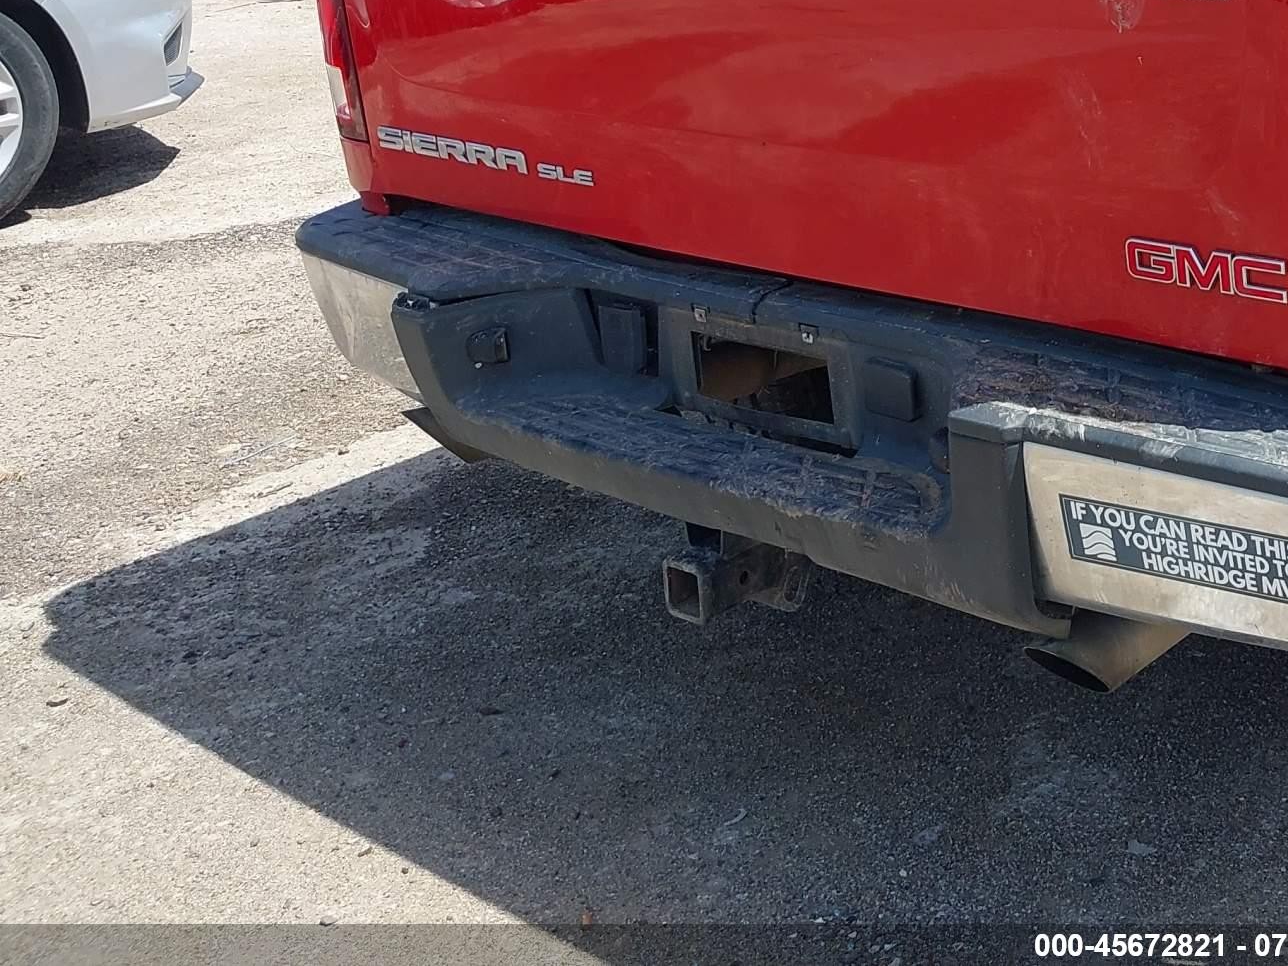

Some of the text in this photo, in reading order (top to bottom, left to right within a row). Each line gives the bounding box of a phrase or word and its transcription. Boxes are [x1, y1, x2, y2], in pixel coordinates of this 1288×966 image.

[377, 125, 594, 186] SIERRA SLE
[1125, 238, 1288, 304] GMC
[1069, 500, 1087, 520] IF
[1088, 503, 1136, 530] YOU
[1139, 514, 1187, 540] CAN
[1189, 523, 1248, 551] READ
[1118, 528, 1191, 559] YOU'RE
[1192, 544, 1270, 574] INVITED
[1141, 551, 1259, 592] HIGHRIDGE
